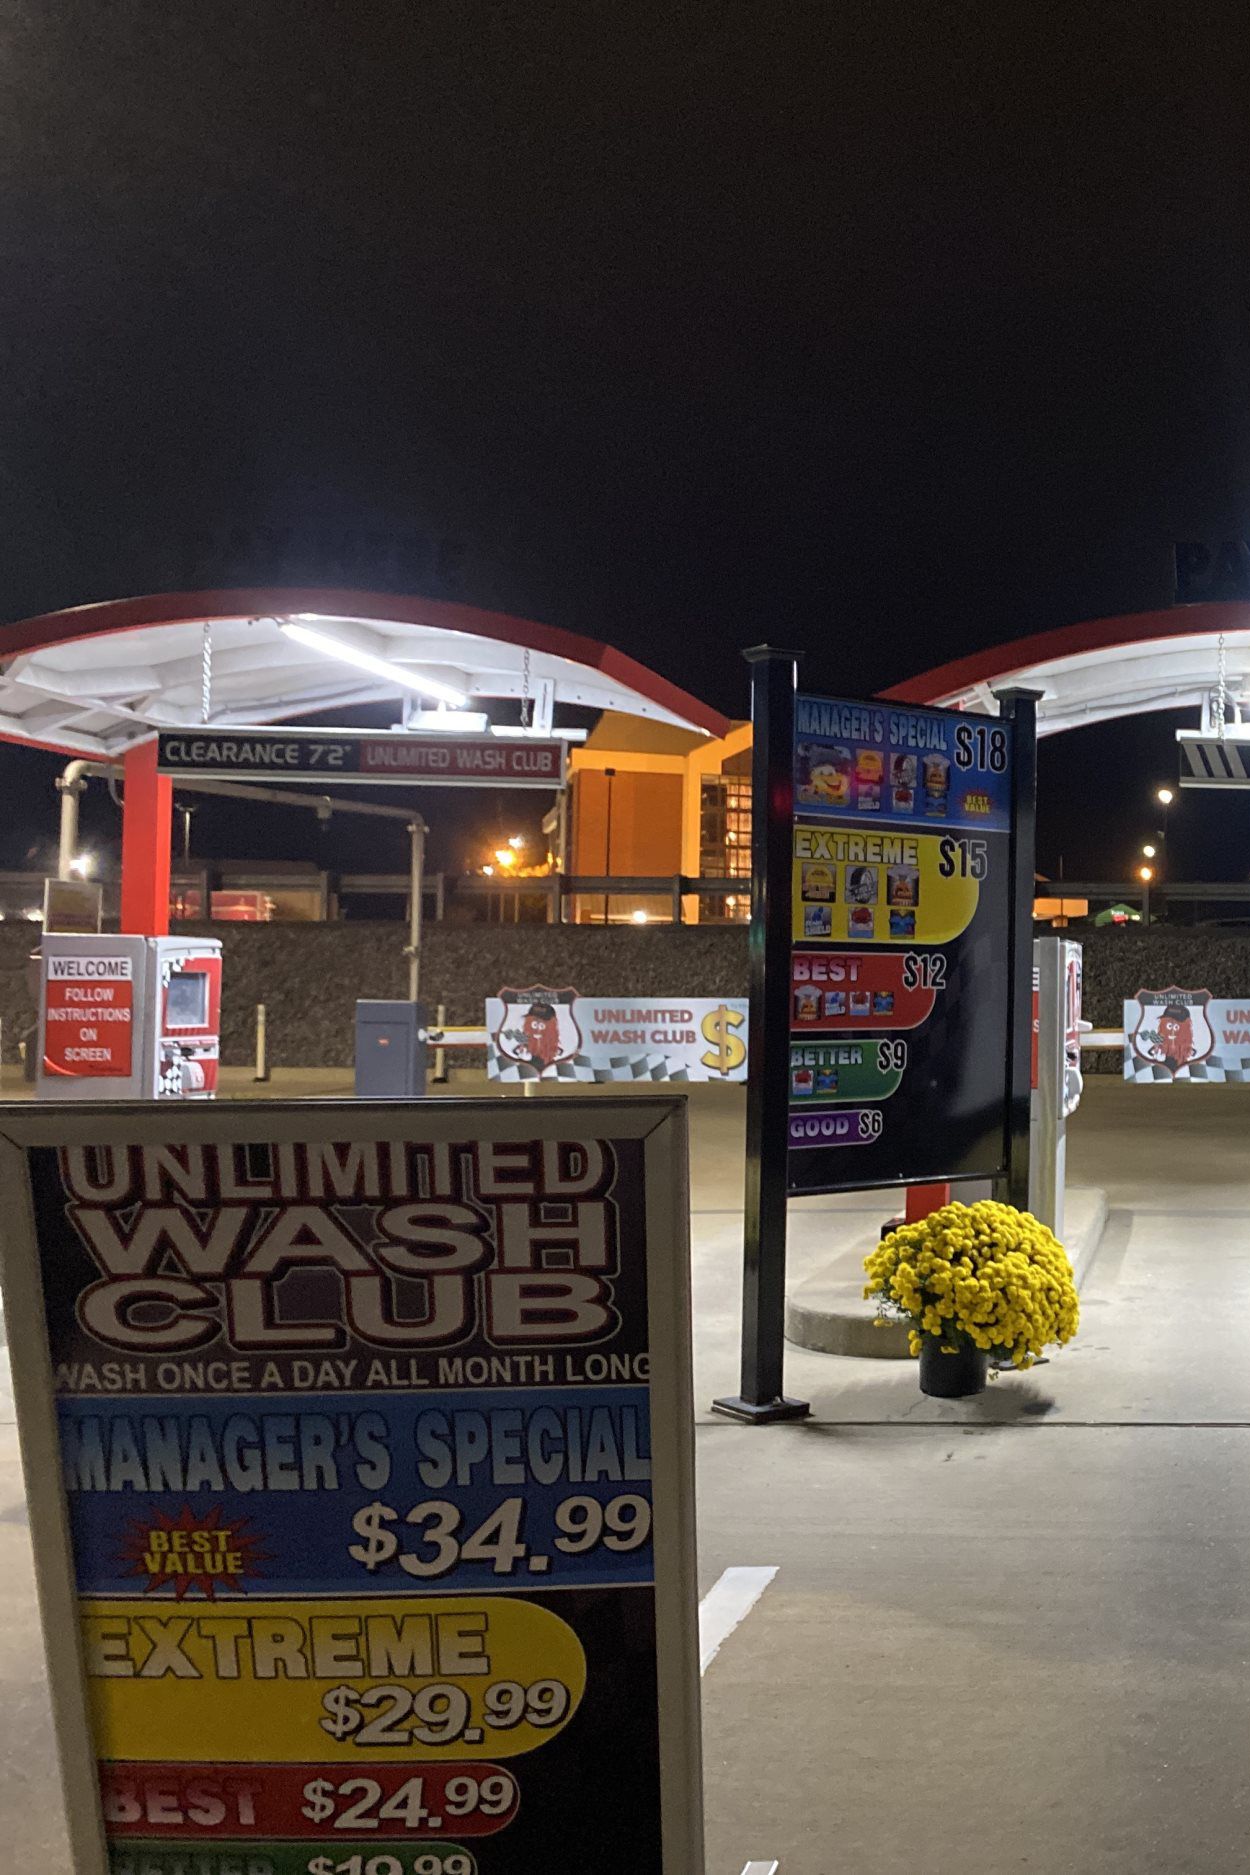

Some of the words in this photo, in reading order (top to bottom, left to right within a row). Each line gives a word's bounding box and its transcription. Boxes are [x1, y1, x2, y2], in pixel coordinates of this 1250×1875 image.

[797, 700, 884, 744] MANAGER'S
[889, 712, 948, 752] SPECIAL
[165, 740, 299, 765] CLEARANCE
[367, 745, 448, 769] UNLIMITED
[457, 748, 505, 771] WASH
[513, 750, 552, 772] CLUB
[954, 721, 1009, 774] $18
[794, 828, 919, 866] EXTREME
[938, 834, 988, 881] $15
[52, 960, 129, 977] WELCOME
[793, 957, 861, 982] BEST
[903, 951, 947, 992] $12
[64, 987, 114, 1001] FOLLOW
[47, 1008, 131, 1022] INSTRUCTIONS
[593, 1009, 693, 1024] UNLIMITED
[79, 1027, 98, 1041] ON
[590, 1030, 646, 1045] WASH
[650, 1030, 697, 1045] CLUB
[64, 1047, 112, 1062] SCREEN
[790, 1046, 863, 1068] BETTER
[877, 1038, 908, 1075] $9
[790, 1117, 849, 1138] GOOD
[858, 1110, 883, 1139] $6
[66, 1139, 606, 1201] UNLIMITED
[70, 1202, 610, 1275] WASH
[82, 1273, 612, 1347] CLUB
[56, 1361, 146, 1390] WASH
[156, 1360, 251, 1390] ONCE
[260, 1361, 284, 1388] A
[292, 1359, 359, 1388] DAY
[365, 1358, 430, 1386] ALL
[437, 1354, 554, 1385] MONTH
[565, 1352, 650, 1382] LONG
[61, 1408, 391, 1493] MANAGER'S
[414, 1404, 652, 1490] SPECIAL
[149, 1529, 230, 1553] BEST
[348, 1494, 653, 1578] $34.99
[143, 1552, 244, 1576] VALUE
[82, 1612, 490, 1680] EXTREME
[320, 1679, 571, 1746] $29.99
[104, 1775, 264, 1827] BEST
[300, 1775, 514, 1829] $24.99
